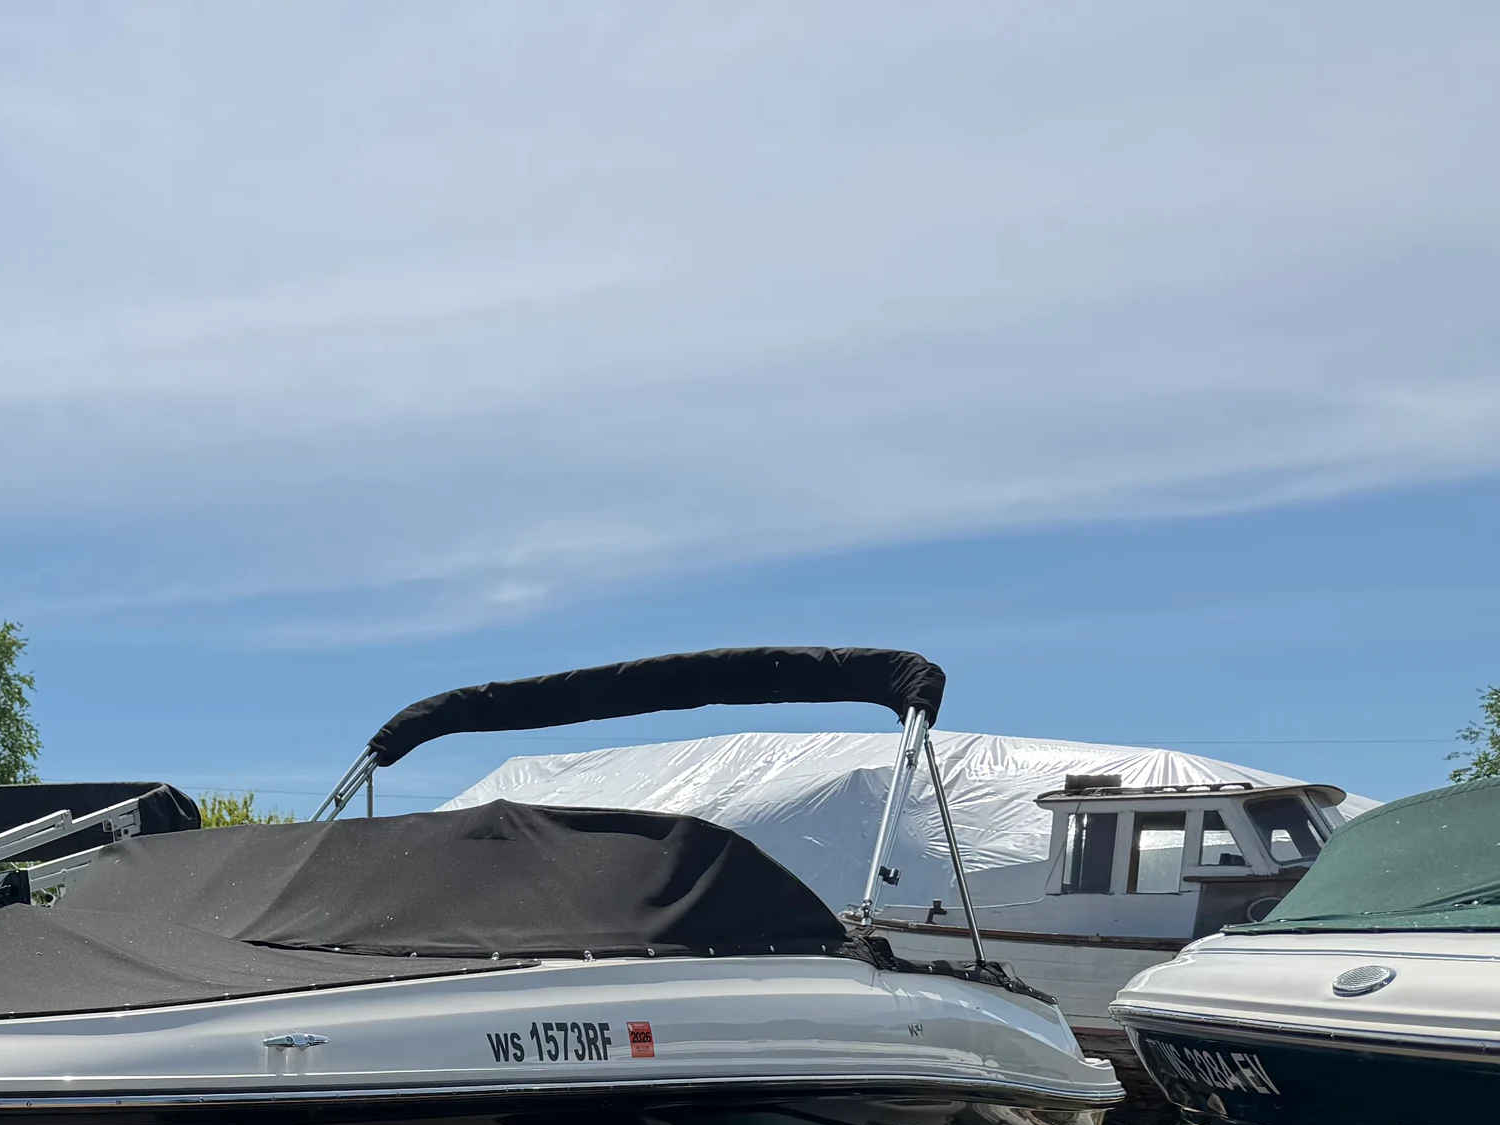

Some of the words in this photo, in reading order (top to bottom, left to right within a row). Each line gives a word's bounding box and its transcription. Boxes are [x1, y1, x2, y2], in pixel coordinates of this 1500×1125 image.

[486, 1032, 525, 1063] WS
[530, 1021, 612, 1062] 1573RF
[630, 1031, 652, 1043] 2026
[1156, 1040, 1198, 1083] WS
[1184, 1047, 1248, 1093] 3284
[1230, 1053, 1281, 1095] EV
